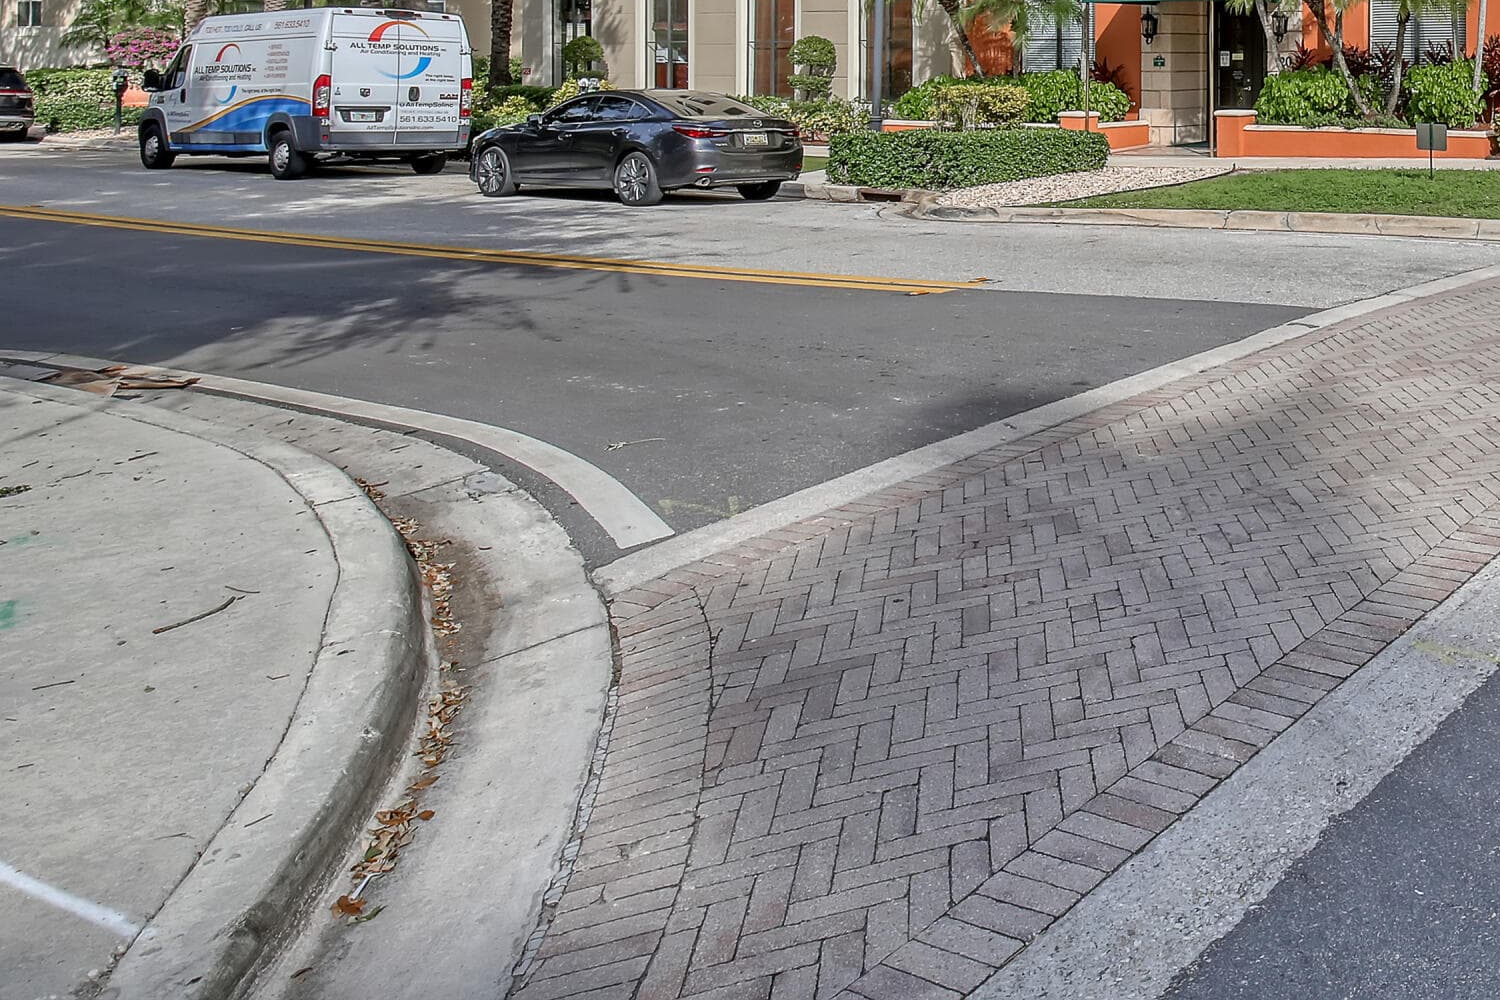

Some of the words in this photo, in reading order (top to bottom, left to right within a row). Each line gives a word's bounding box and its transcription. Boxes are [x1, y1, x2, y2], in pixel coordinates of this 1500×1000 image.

[367, 42, 392, 50] TEMP
[393, 43, 439, 52] SOLUTIONS
[195, 65, 205, 74] ALL
[205, 65, 220, 74] TEMP
[220, 63, 252, 73] SOLUTIONS
[399, 115, 459, 124] 561.633.5410
